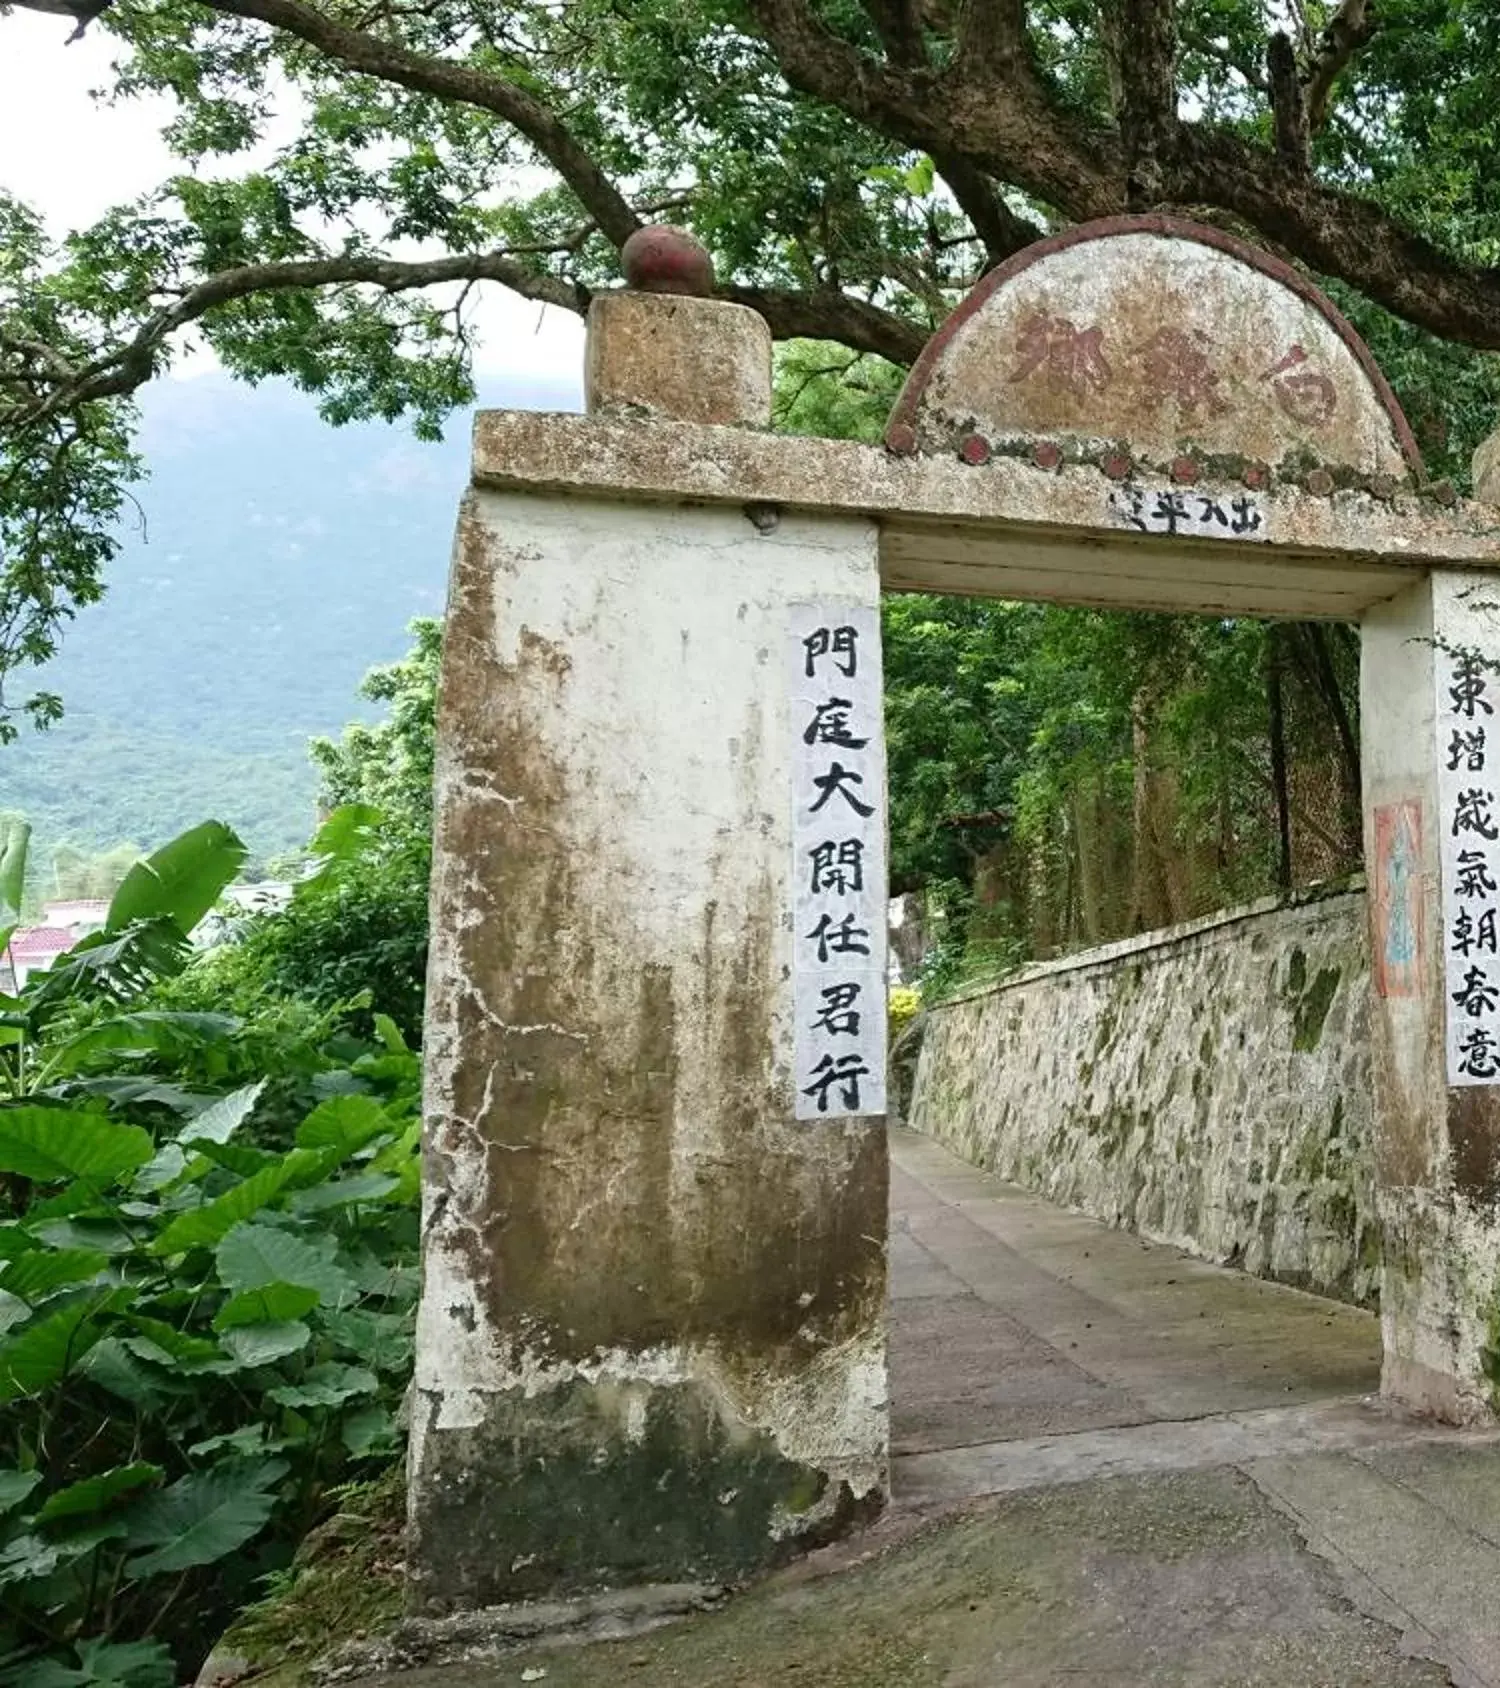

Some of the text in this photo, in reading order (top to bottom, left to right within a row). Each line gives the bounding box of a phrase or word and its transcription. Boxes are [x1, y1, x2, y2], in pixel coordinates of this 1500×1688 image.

[803, 625, 876, 1111] 門庭大開任君行
